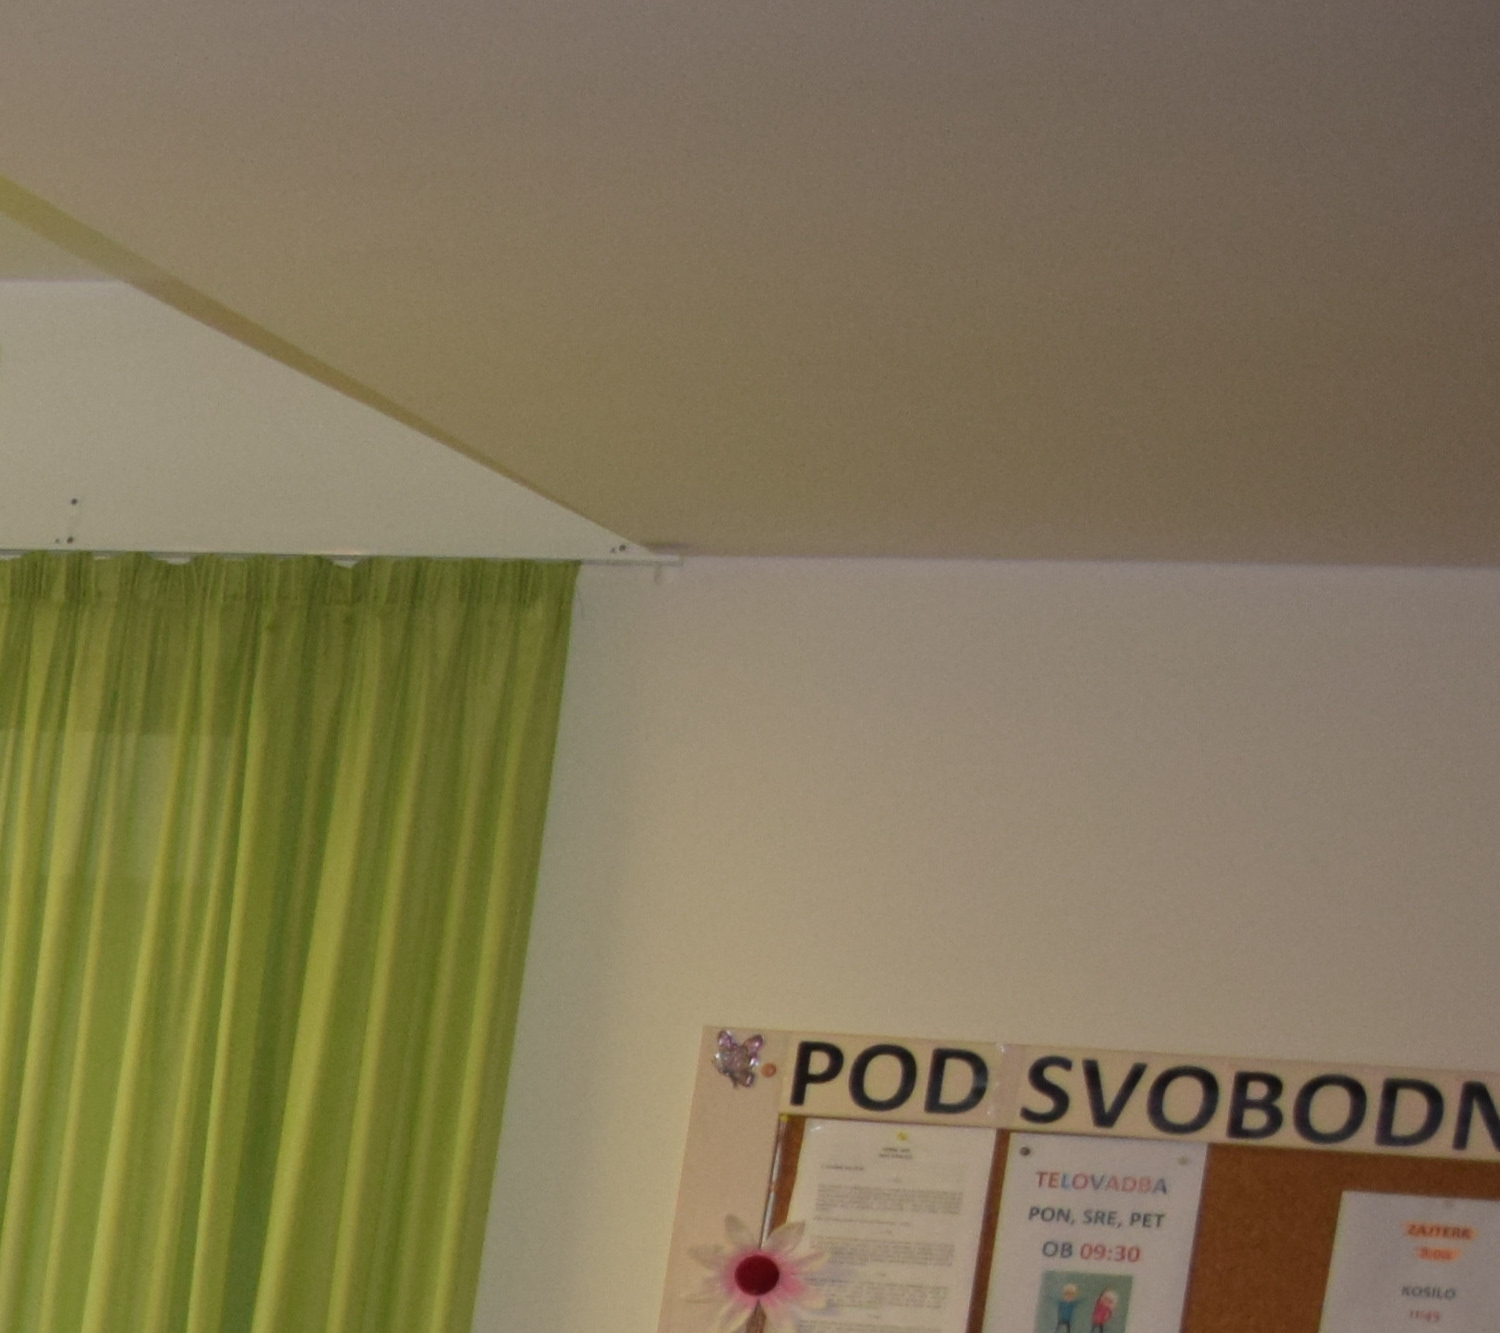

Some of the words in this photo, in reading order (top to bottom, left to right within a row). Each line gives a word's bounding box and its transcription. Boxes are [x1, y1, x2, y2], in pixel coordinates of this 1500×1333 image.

[790, 1041, 989, 1115] POD
[1020, 1055, 1500, 1152] SVOBODN
[1036, 1171, 1168, 1195] TELOVADBA
[1028, 1206, 1075, 1227] PON,
[1082, 1209, 1122, 1229] SRE,
[1129, 1212, 1165, 1228] PET
[1041, 1240, 1073, 1258] OB
[1079, 1243, 1141, 1263] 09:30
